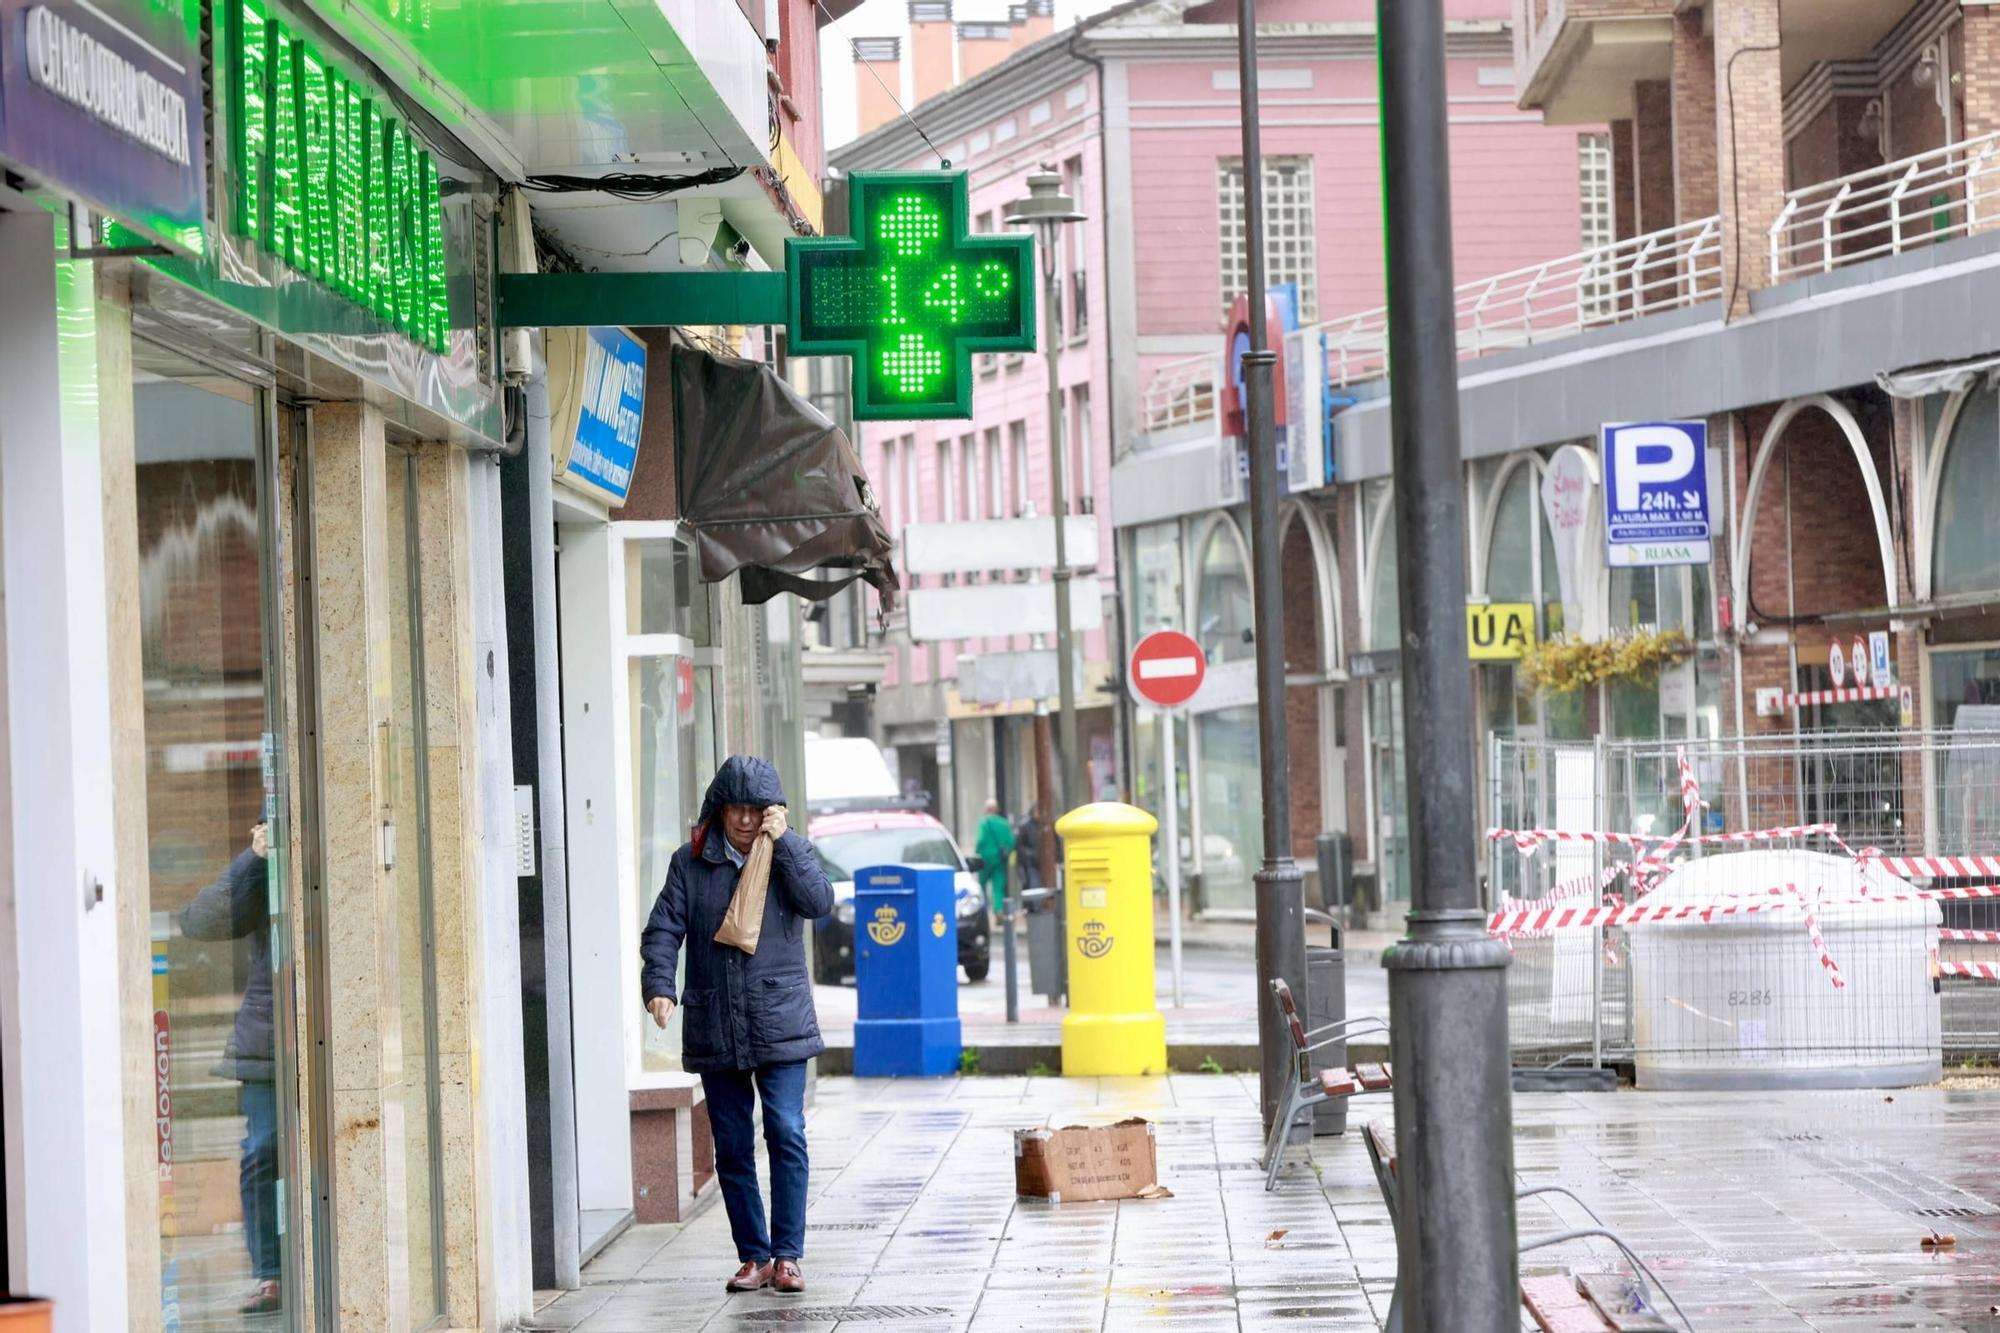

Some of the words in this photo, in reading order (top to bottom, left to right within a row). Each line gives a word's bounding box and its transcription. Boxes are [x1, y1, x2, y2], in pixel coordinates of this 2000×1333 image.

[235, 0, 452, 355] FARMACIA
[1614, 426, 1696, 512] P
[1644, 546, 1692, 561] RUASA
[1727, 989, 1773, 1007] 8286
[156, 1030, 172, 1183] Redoxon
